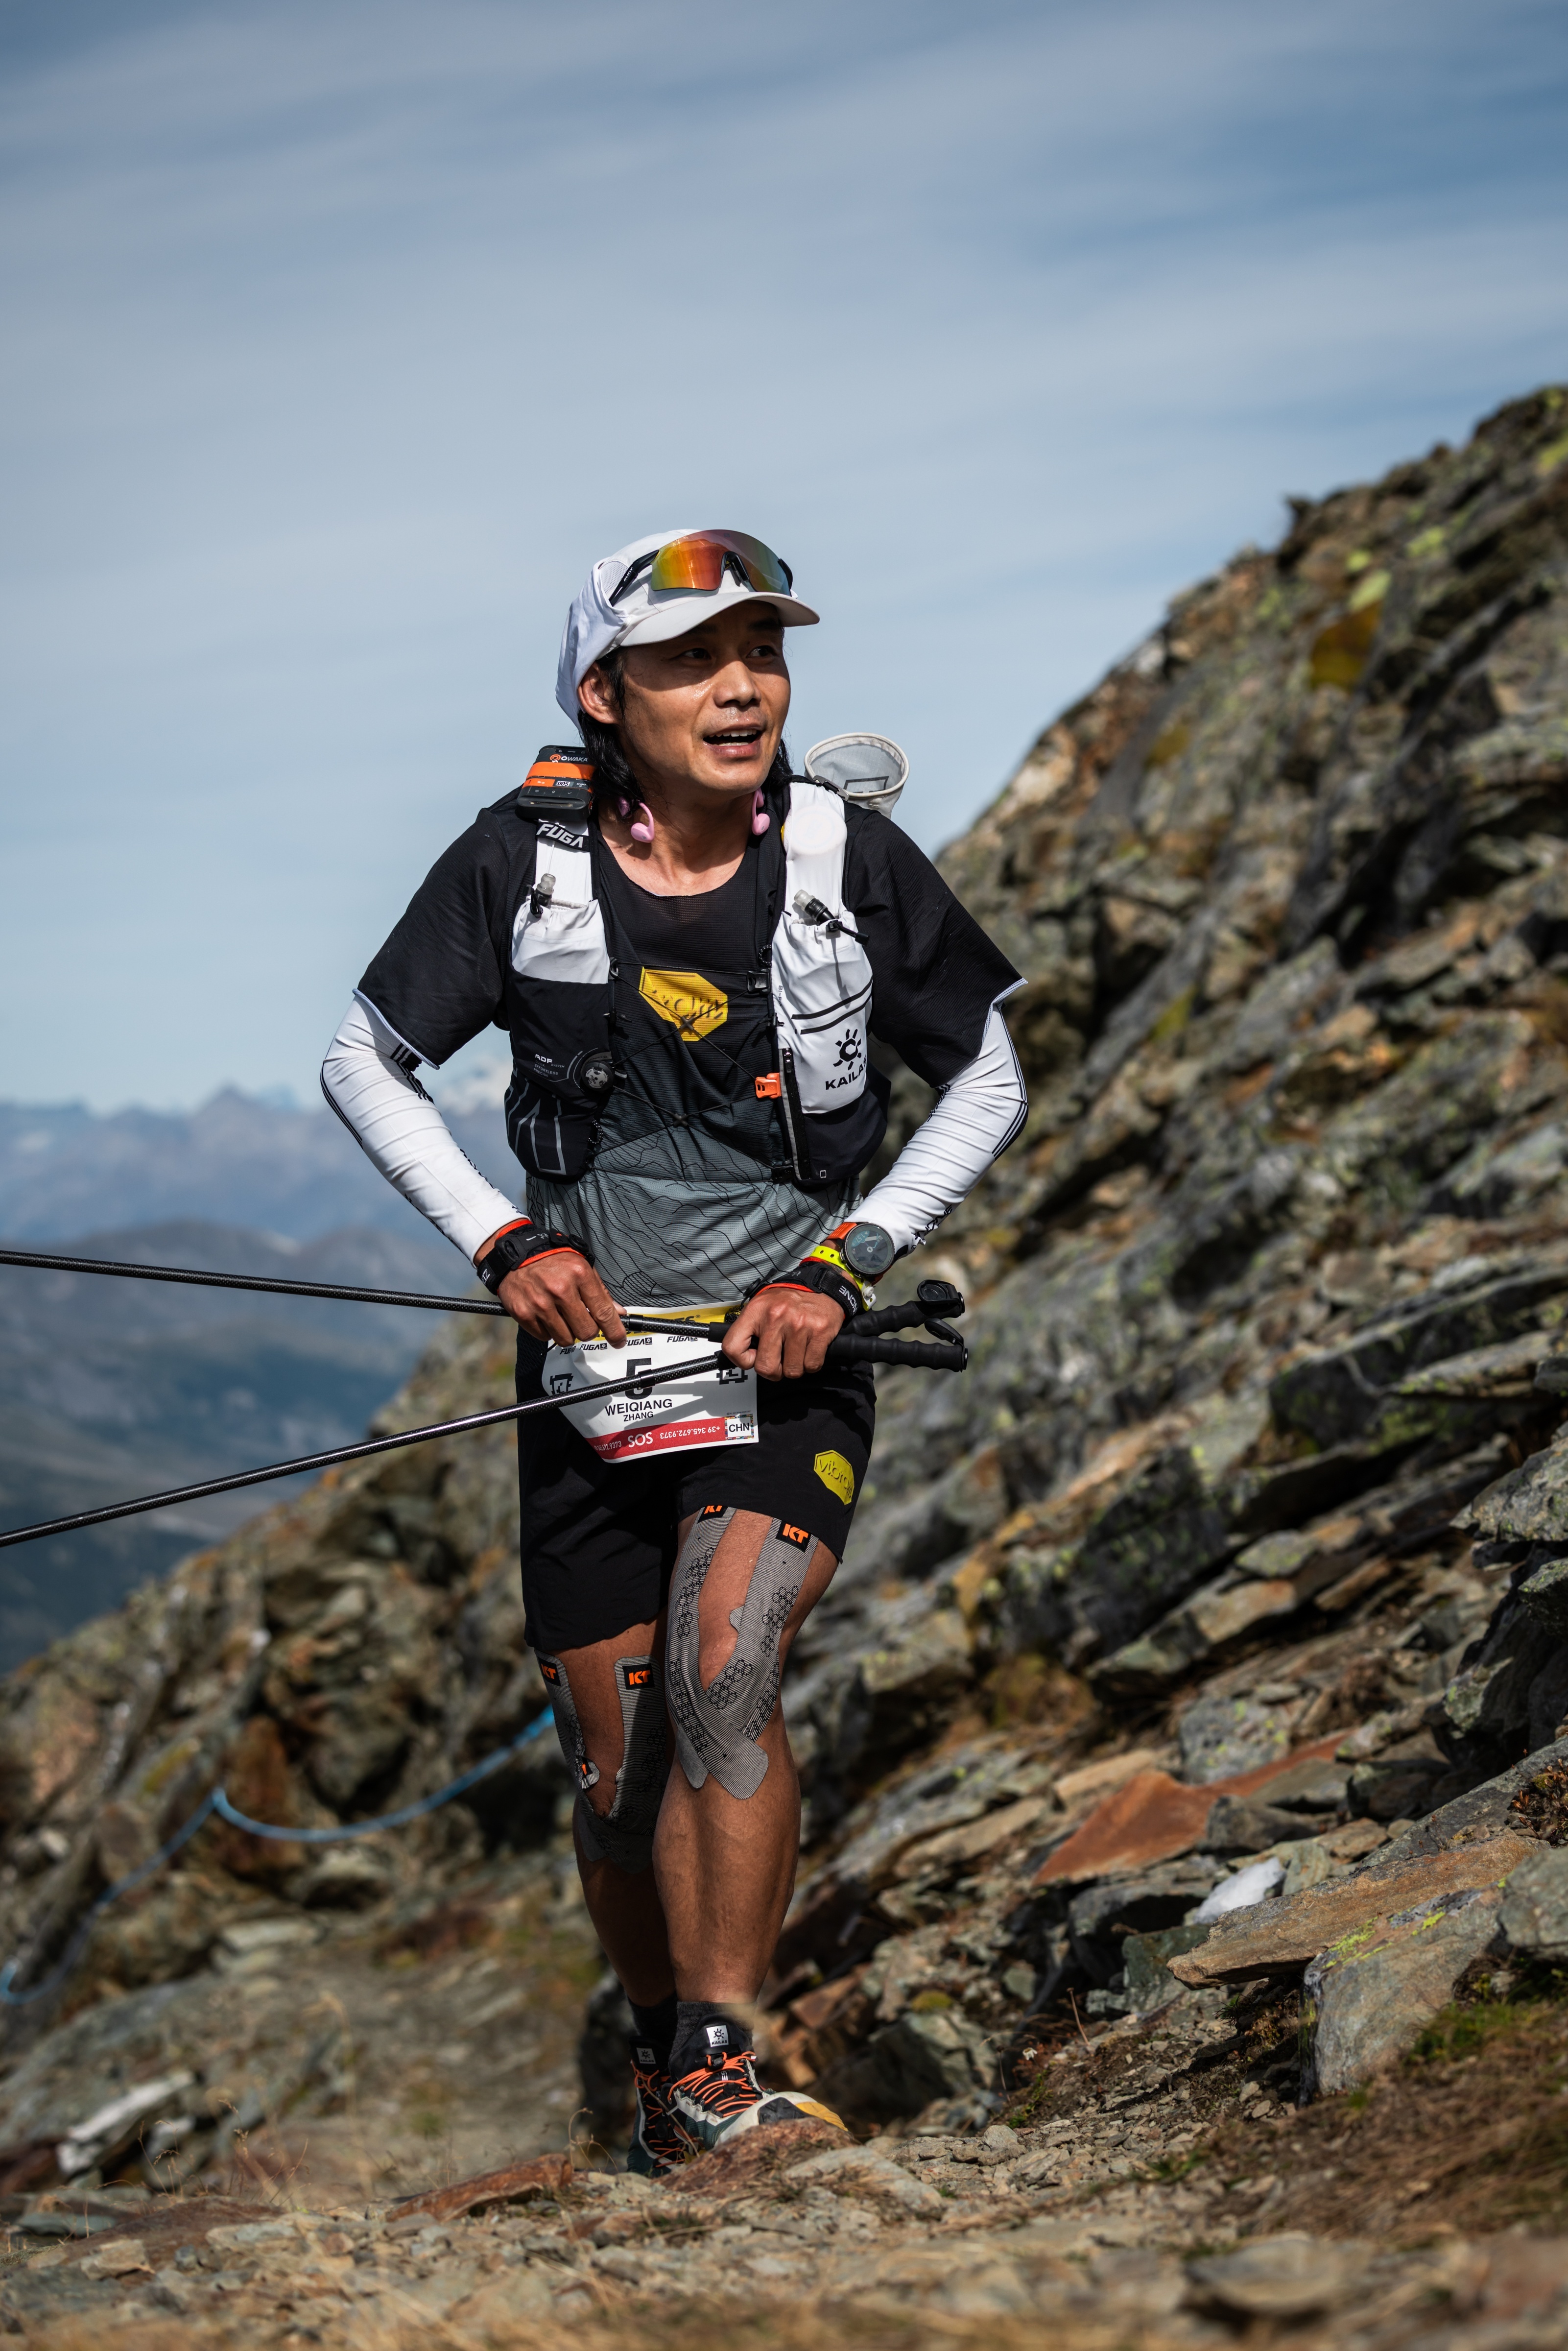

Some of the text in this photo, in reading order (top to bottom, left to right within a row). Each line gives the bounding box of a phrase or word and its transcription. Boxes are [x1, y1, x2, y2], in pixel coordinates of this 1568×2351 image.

[624, 567, 633, 582] RUDY
[536, 823, 584, 848] FUGA
[535, 1054, 552, 1063] ADF
[533, 1068, 549, 1078] PRECISE
[534, 1064, 558, 1075] EFFORTLESS
[825, 1054, 867, 1090] KAILAS
[625, 1358, 653, 1400] 5
[605, 1399, 672, 1416] WEIQIANG
[623, 1411, 654, 1421] ZHANG
[660, 1427, 706, 1439] 345.672.9373
[729, 1422, 750, 1432] CHN
[627, 1432, 653, 1447] SOS
[782, 1523, 808, 1543] KT
[541, 1663, 556, 1679] KT
[628, 1669, 651, 1685] KT
